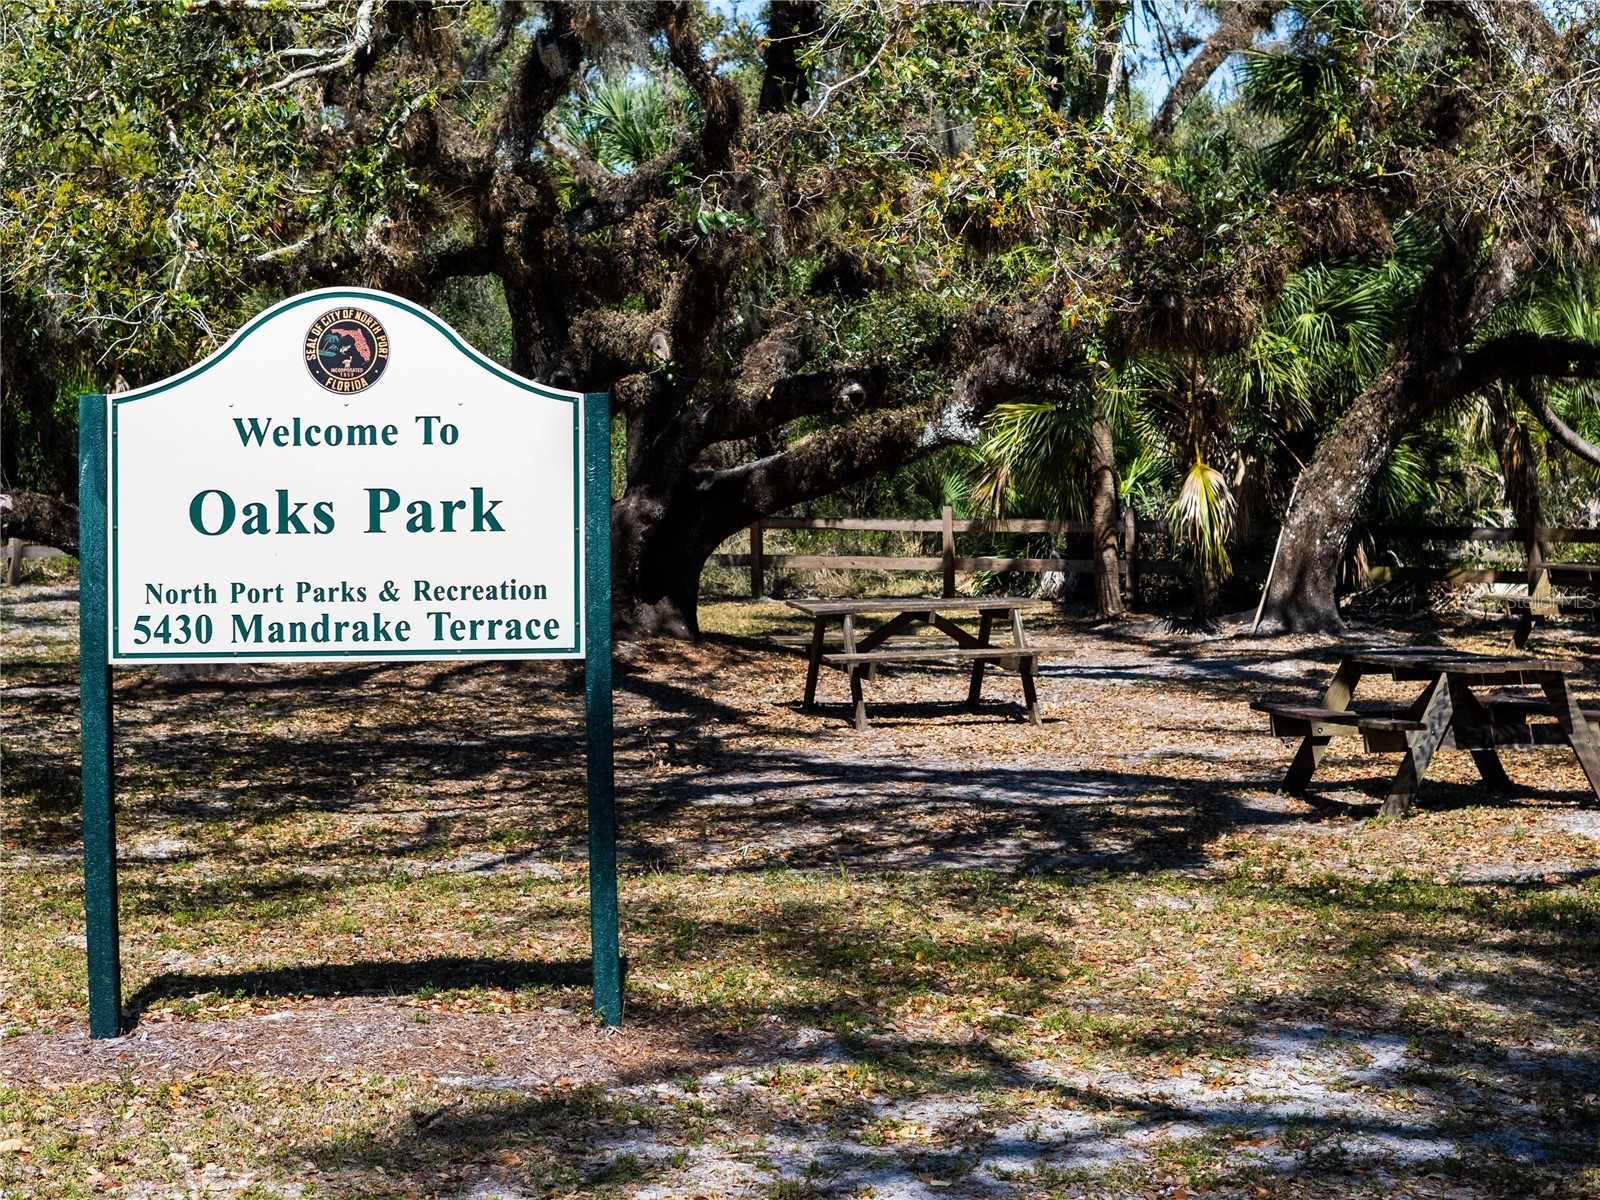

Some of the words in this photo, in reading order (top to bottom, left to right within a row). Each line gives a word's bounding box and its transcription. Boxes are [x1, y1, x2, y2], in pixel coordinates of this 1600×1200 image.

[321, 311, 341, 324] CITY
[343, 309, 354, 318] OF
[355, 311, 382, 333] NORTH
[311, 325, 323, 336] OF
[306, 338, 317, 361] SEAL
[377, 335, 388, 360] PORT
[325, 377, 368, 391] FLORIDA
[233, 417, 398, 448] Welcome
[416, 415, 459, 446] To
[189, 490, 335, 537] Oaks
[363, 487, 506, 534] Park
[145, 583, 217, 605] North
[231, 582, 284, 604] Port
[297, 581, 367, 603] Parks
[379, 581, 401, 603] &
[414, 579, 548, 602] Recreation
[133, 614, 213, 645] 5430
[231, 612, 411, 644] Mandrake
[427, 611, 560, 642] Terrace
